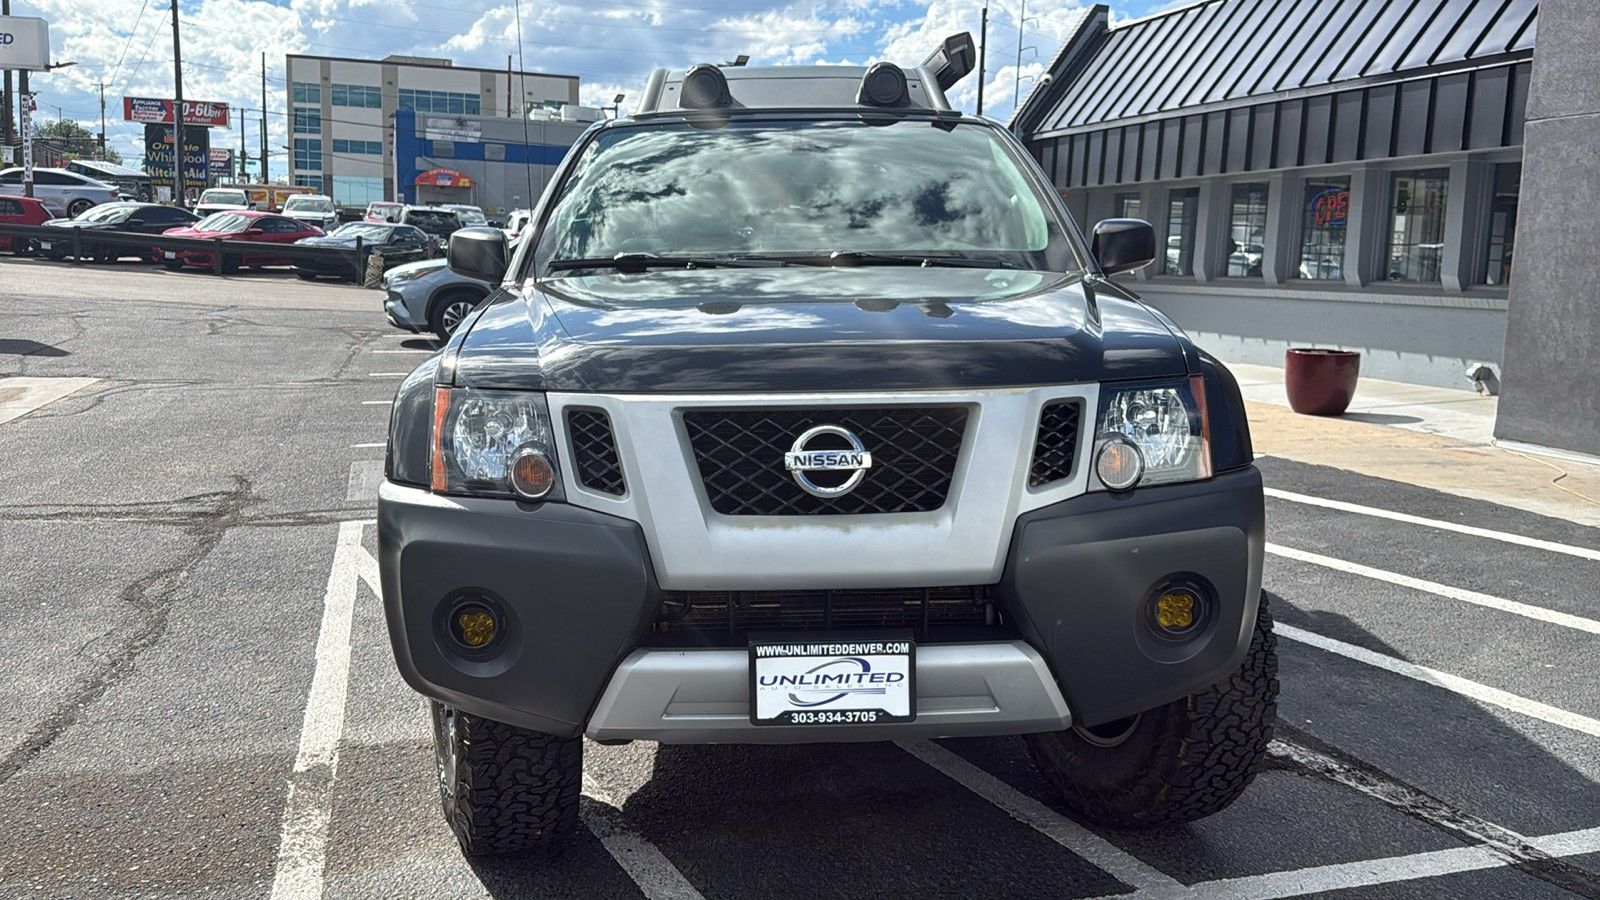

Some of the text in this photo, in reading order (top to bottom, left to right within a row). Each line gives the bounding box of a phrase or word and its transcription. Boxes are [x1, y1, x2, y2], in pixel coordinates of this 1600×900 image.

[152, 142, 170, 150] On
[794, 454, 864, 466] NISSAN
[759, 672, 905, 686] UNLIMITED
[791, 711, 877, 723] 303-934-3705
